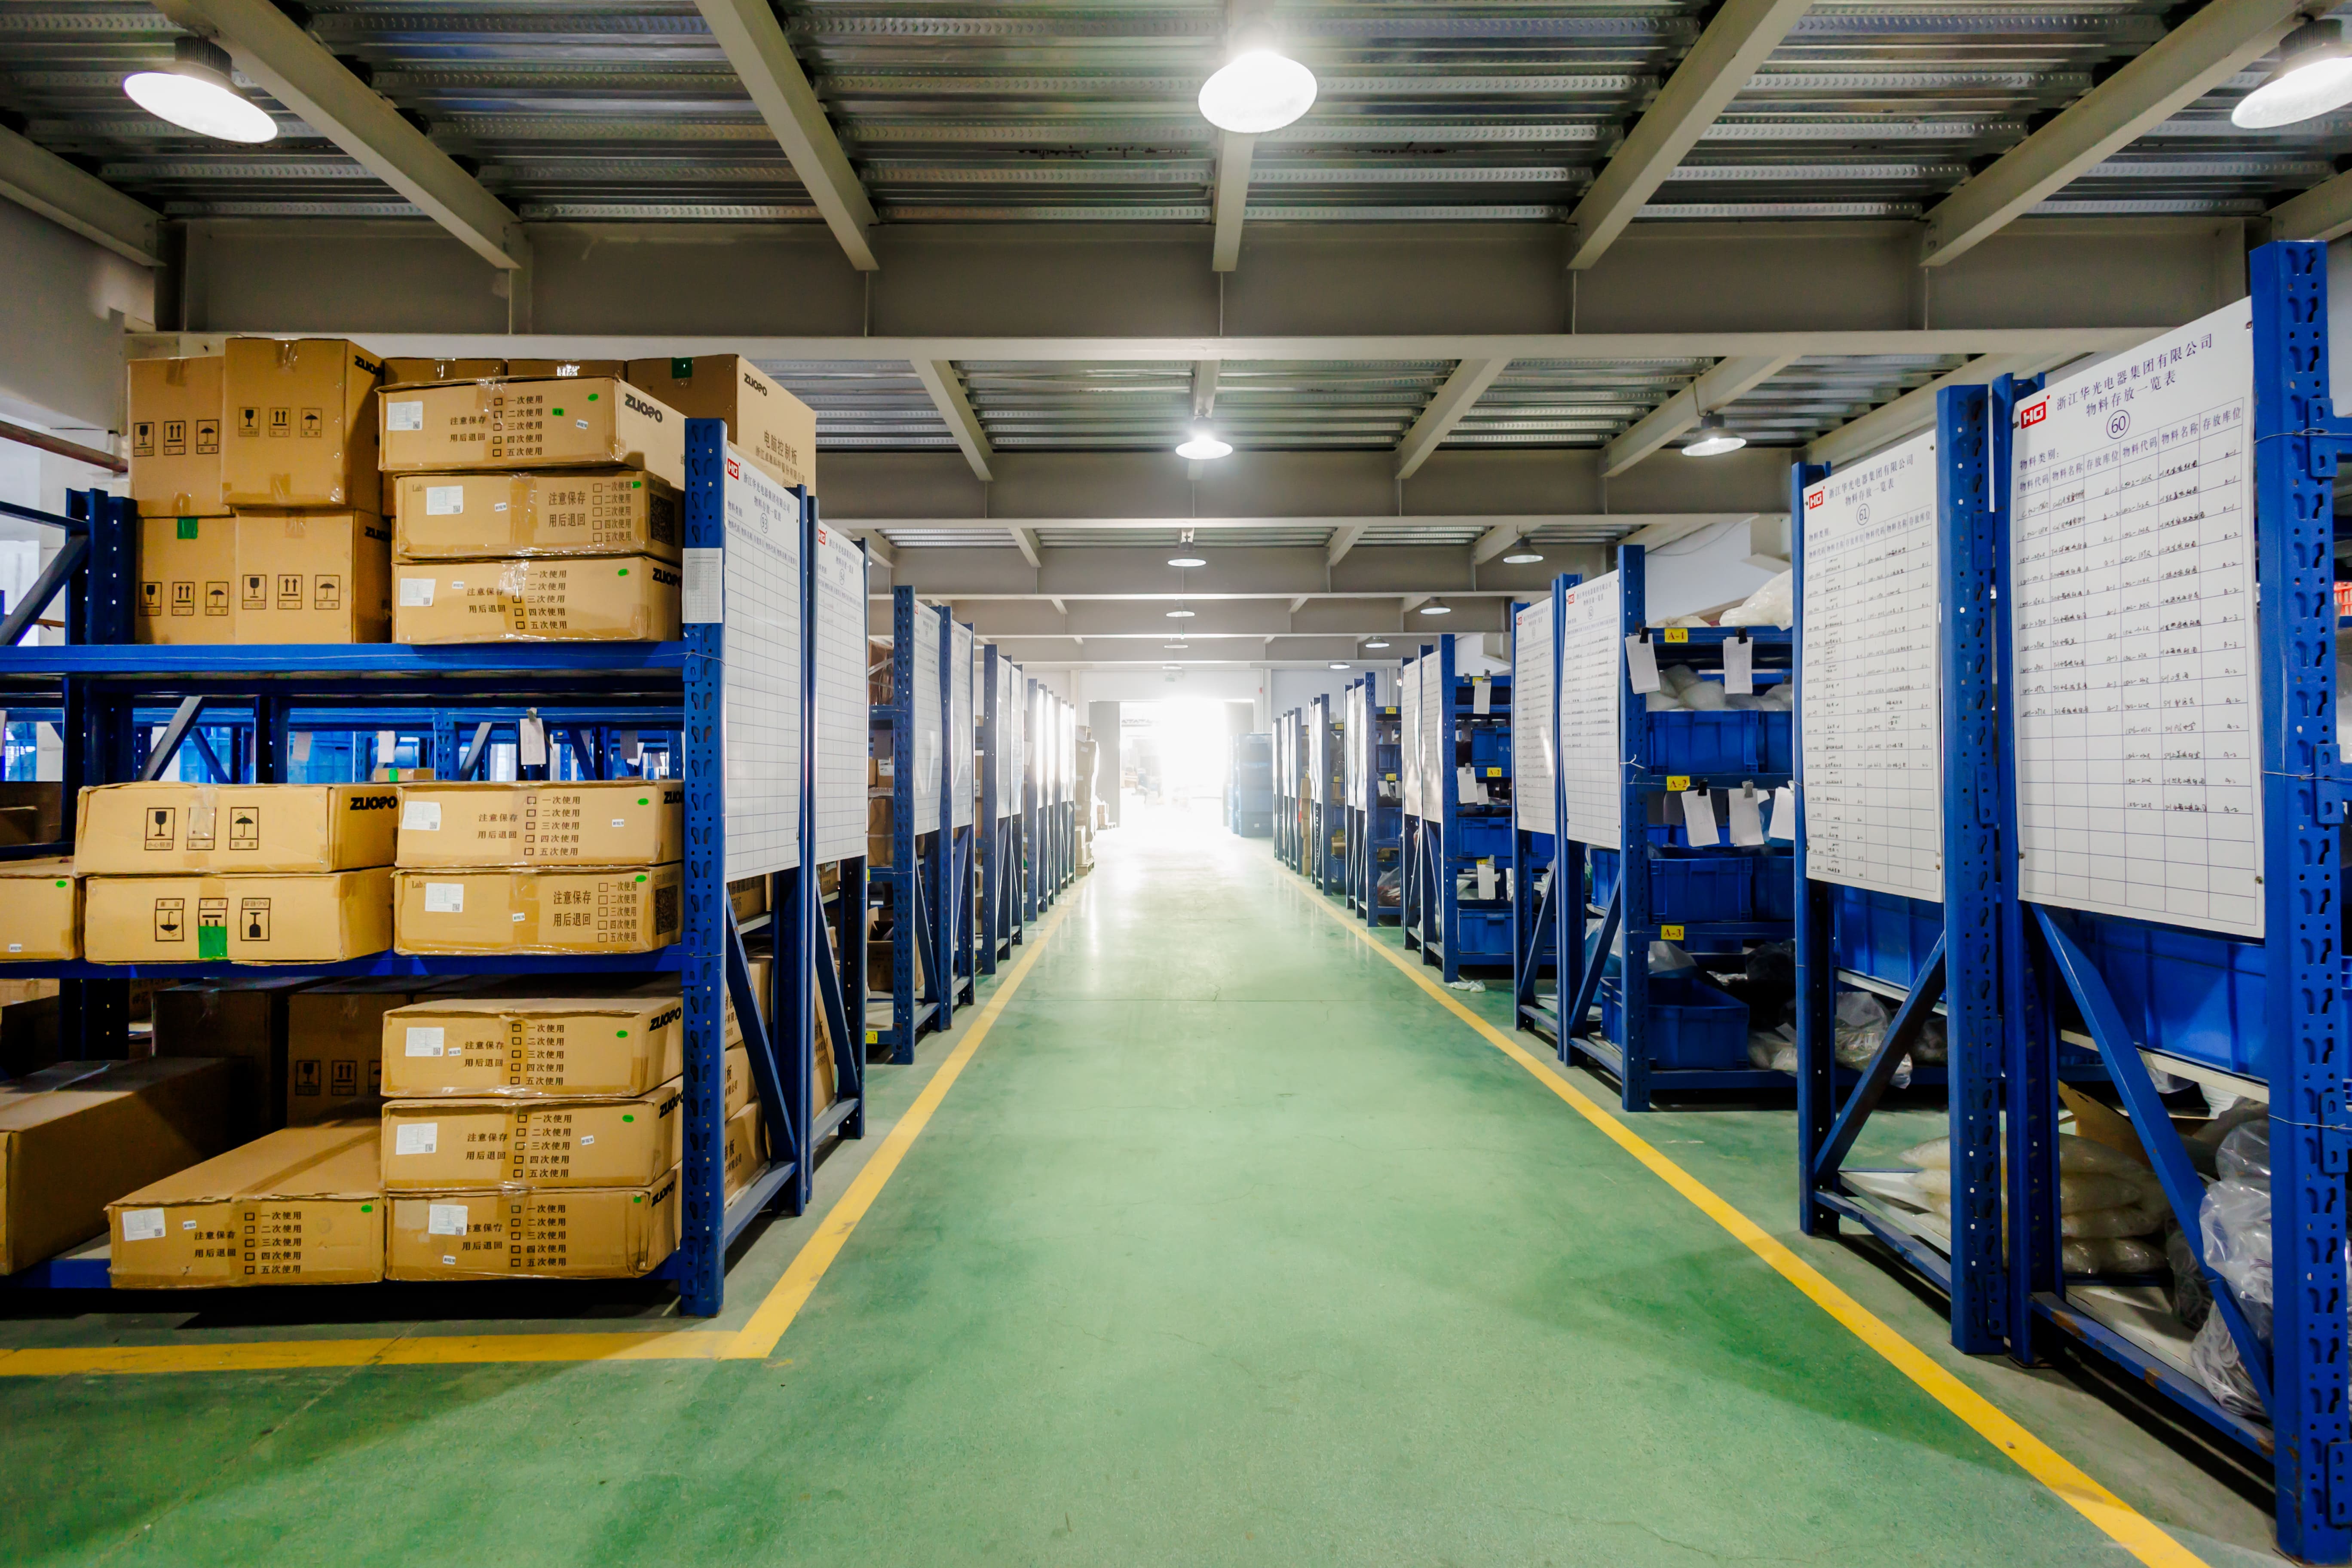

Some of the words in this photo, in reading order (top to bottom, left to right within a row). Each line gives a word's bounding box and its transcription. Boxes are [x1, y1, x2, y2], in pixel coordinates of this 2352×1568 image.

[2057, 333, 2212, 410] 浙江华光电器集团有限公司
[2086, 370, 2176, 417] 物料存放一览表
[508, 396, 543, 405] 一次使用
[508, 408, 543, 418] 二次使用
[450, 416, 486, 426] 注意保存
[508, 421, 543, 430] 三次使用
[2111, 415, 2126, 433] 60
[450, 433, 485, 442] 用后退回
[507, 434, 542, 443] 四次使用
[507, 447, 542, 456] 五次使用
[764, 430, 797, 466] 电脑控制板
[2020, 472, 2049, 491] 物料代码
[2052, 461, 2083, 481] 物料名称
[2086, 450, 2119, 470] 存放库位
[2122, 436, 2157, 458] 物料代码
[2162, 422, 2199, 444] 物料名称
[2202, 406, 2241, 431] 存放库位
[1829, 454, 1914, 499] 浙江华光电器集团有限公司
[604, 481, 631, 491] 一次使用
[1845, 478, 1895, 507] 物料存放一览表
[548, 490, 586, 506] 注意保存
[604, 494, 631, 504] 二次使用
[604, 506, 631, 516] 三次使用
[1859, 508, 1868, 521] 61
[549, 513, 585, 528] 用后退回
[604, 519, 631, 529] 四次使用
[762, 517, 768, 530] 93
[1865, 526, 1886, 540] 物料代码
[1886, 518, 1907, 533] 物料名称
[1909, 510, 1931, 525] 存放库位
[604, 532, 631, 542] 五次使用
[529, 570, 567, 579] 一次使用
[528, 582, 566, 591] 二次使用
[467, 588, 504, 597] 注意保存
[527, 595, 565, 604] 三次使用
[469, 604, 506, 614] 用后退回
[528, 608, 566, 617] 四次使用
[530, 621, 567, 630] 五次使用
[1668, 632, 1686, 640] A-1
[1670, 779, 1688, 788] A-2
[542, 796, 580, 805] 一次使用
[479, 813, 518, 822] 注意保存
[542, 808, 580, 818] 二次使用
[541, 821, 579, 830] 三次使用
[478, 830, 517, 839] 用后退回
[541, 834, 579, 843] 四次使用
[540, 847, 578, 856] 五次使用
[610, 881, 637, 892] 一次使用
[554, 890, 591, 905] 注意保存
[610, 894, 637, 904] 二次使用
[610, 906, 637, 917] 三次使用
[553, 913, 591, 927] 用后退回
[610, 919, 637, 930] 四次使用
[610, 932, 637, 943] 五次使用
[1664, 929, 1682, 938] A-3
[527, 1024, 564, 1033] 一次使用
[465, 1041, 504, 1050] 注意保存
[527, 1037, 564, 1046] 二次使用
[527, 1050, 564, 1059] 三次使用
[465, 1058, 503, 1068] 用后退回
[527, 1063, 564, 1072] 四次使用
[526, 1076, 564, 1086] 五次使用
[533, 1114, 572, 1124] 一次使用
[467, 1133, 508, 1142] 注意保存
[532, 1128, 571, 1137] 二次使用
[531, 1141, 570, 1151] 三次使用
[466, 1151, 506, 1161] 用后退回
[530, 1155, 570, 1164] 四次使用
[529, 1168, 569, 1178] 五次使用
[527, 1204, 566, 1213] 一次使用
[261, 1211, 302, 1220] 一次使用
[527, 1218, 566, 1227] 二次使用
[261, 1225, 302, 1234] 二次使用
[194, 1230, 236, 1240] 注意保存
[527, 1231, 566, 1240] 三次使用
[261, 1238, 302, 1247] 三次使用
[462, 1240, 502, 1251] 用后退回
[195, 1248, 236, 1258] 用后退回
[527, 1244, 566, 1254] 四次使用
[261, 1251, 301, 1260] 四次使用
[527, 1258, 566, 1267] 五次使用
[261, 1265, 301, 1274] 五次使用
